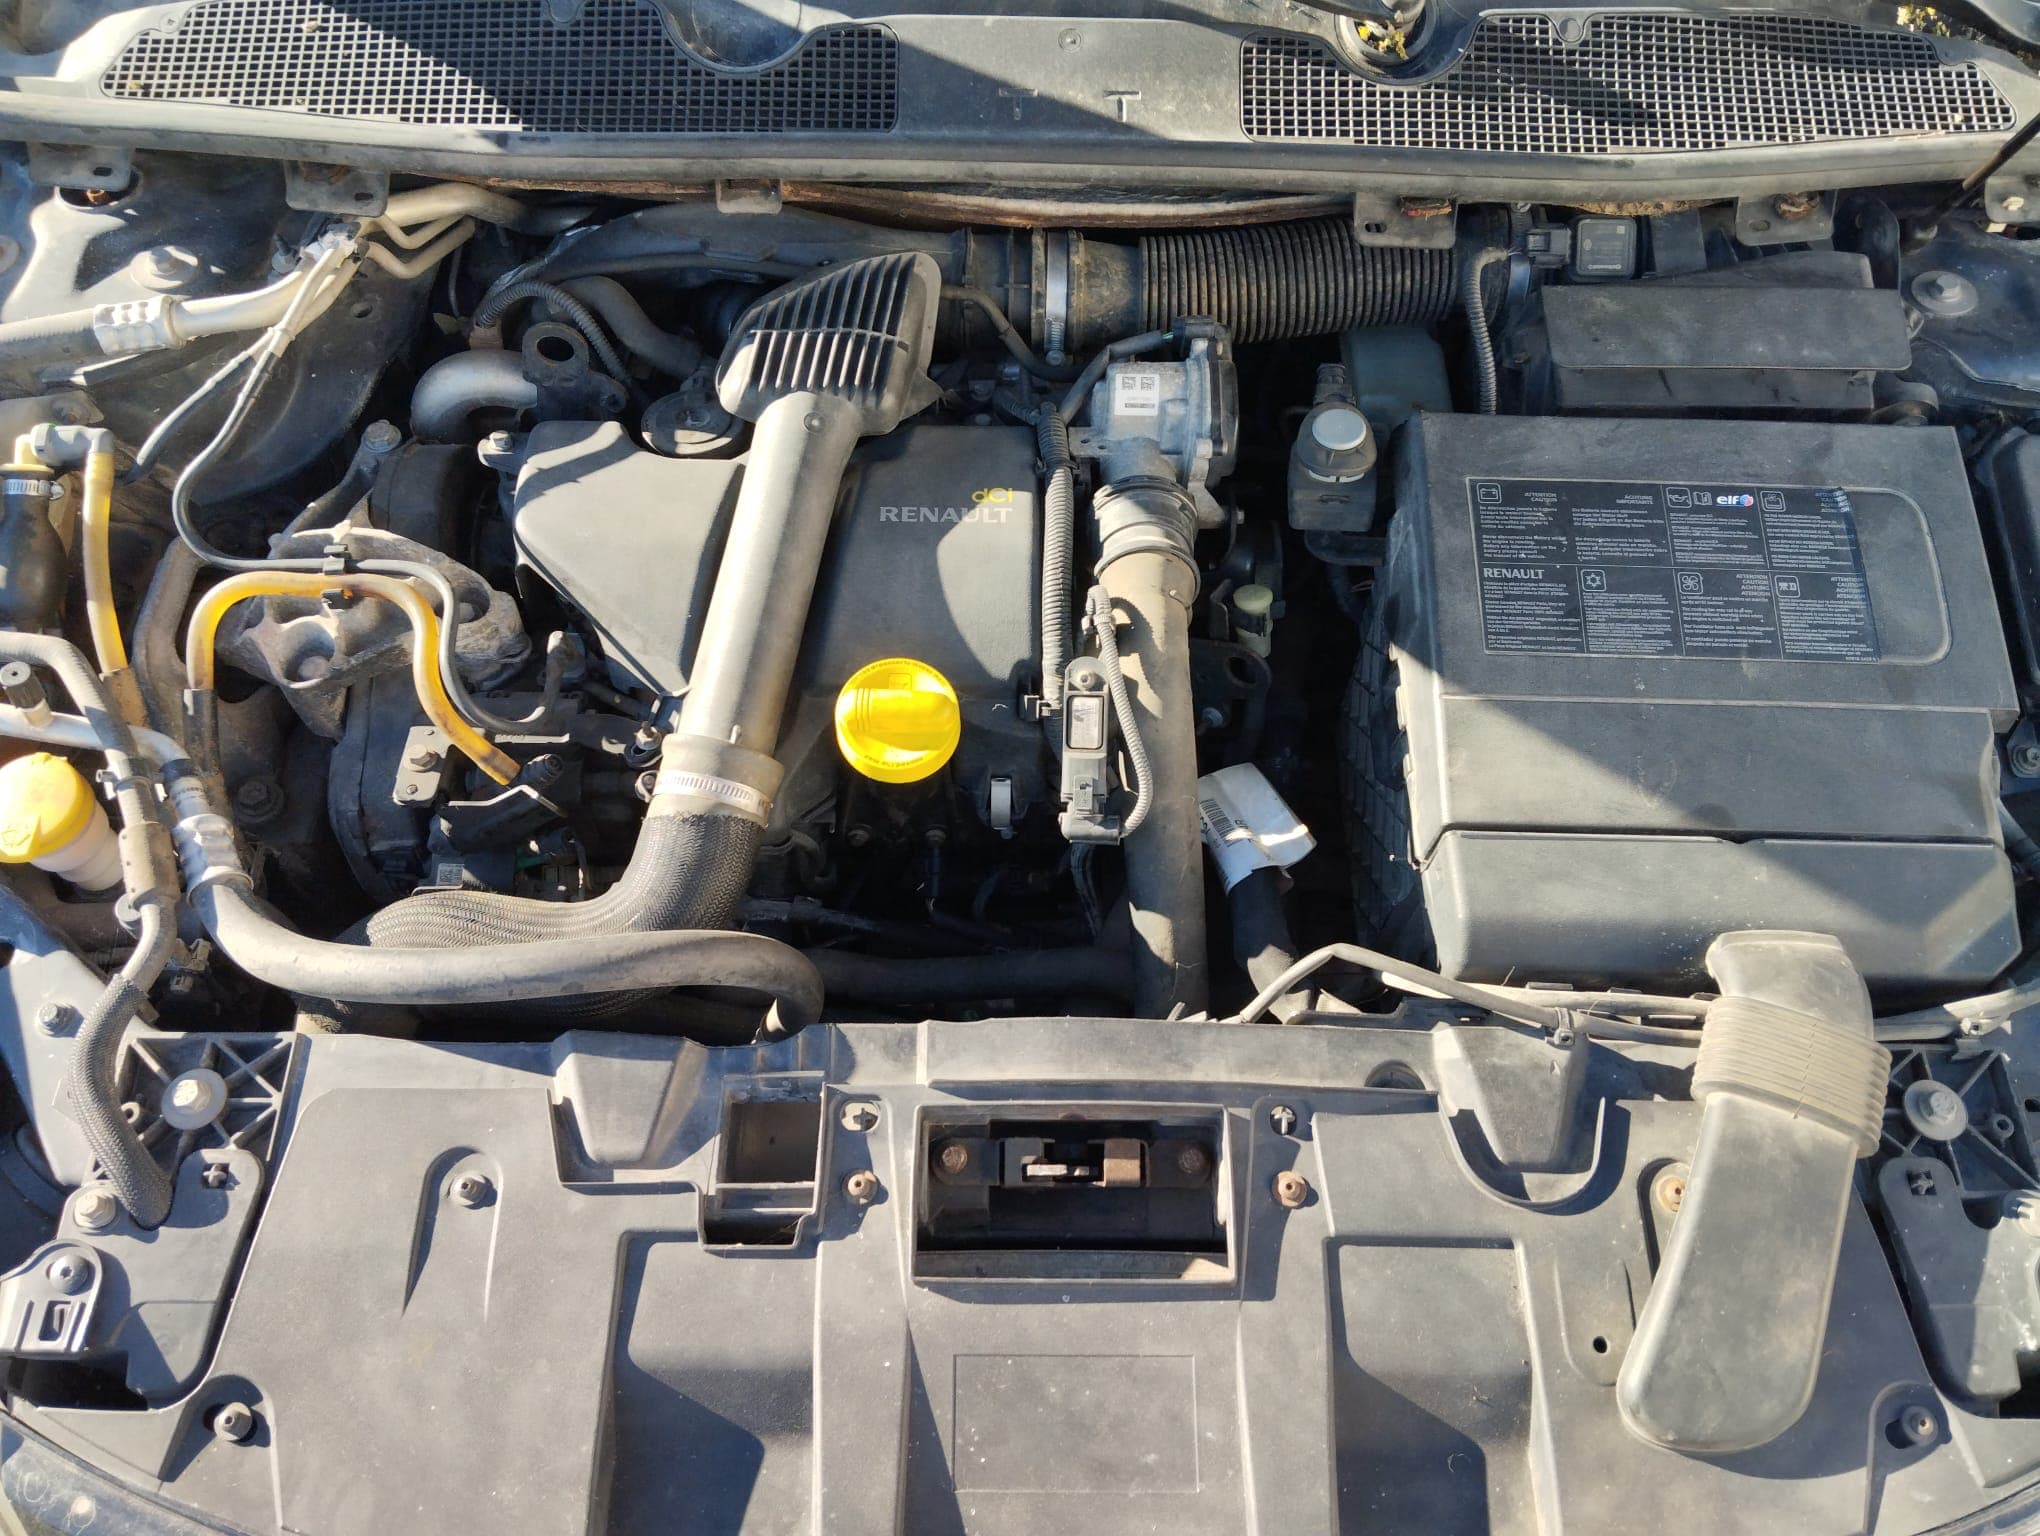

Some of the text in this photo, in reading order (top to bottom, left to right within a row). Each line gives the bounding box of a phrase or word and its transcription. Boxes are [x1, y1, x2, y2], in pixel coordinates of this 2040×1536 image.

[1716, 495, 1740, 505] elf
[880, 506, 1013, 523] RENAULT
[1483, 567, 1545, 579] RENAULT
